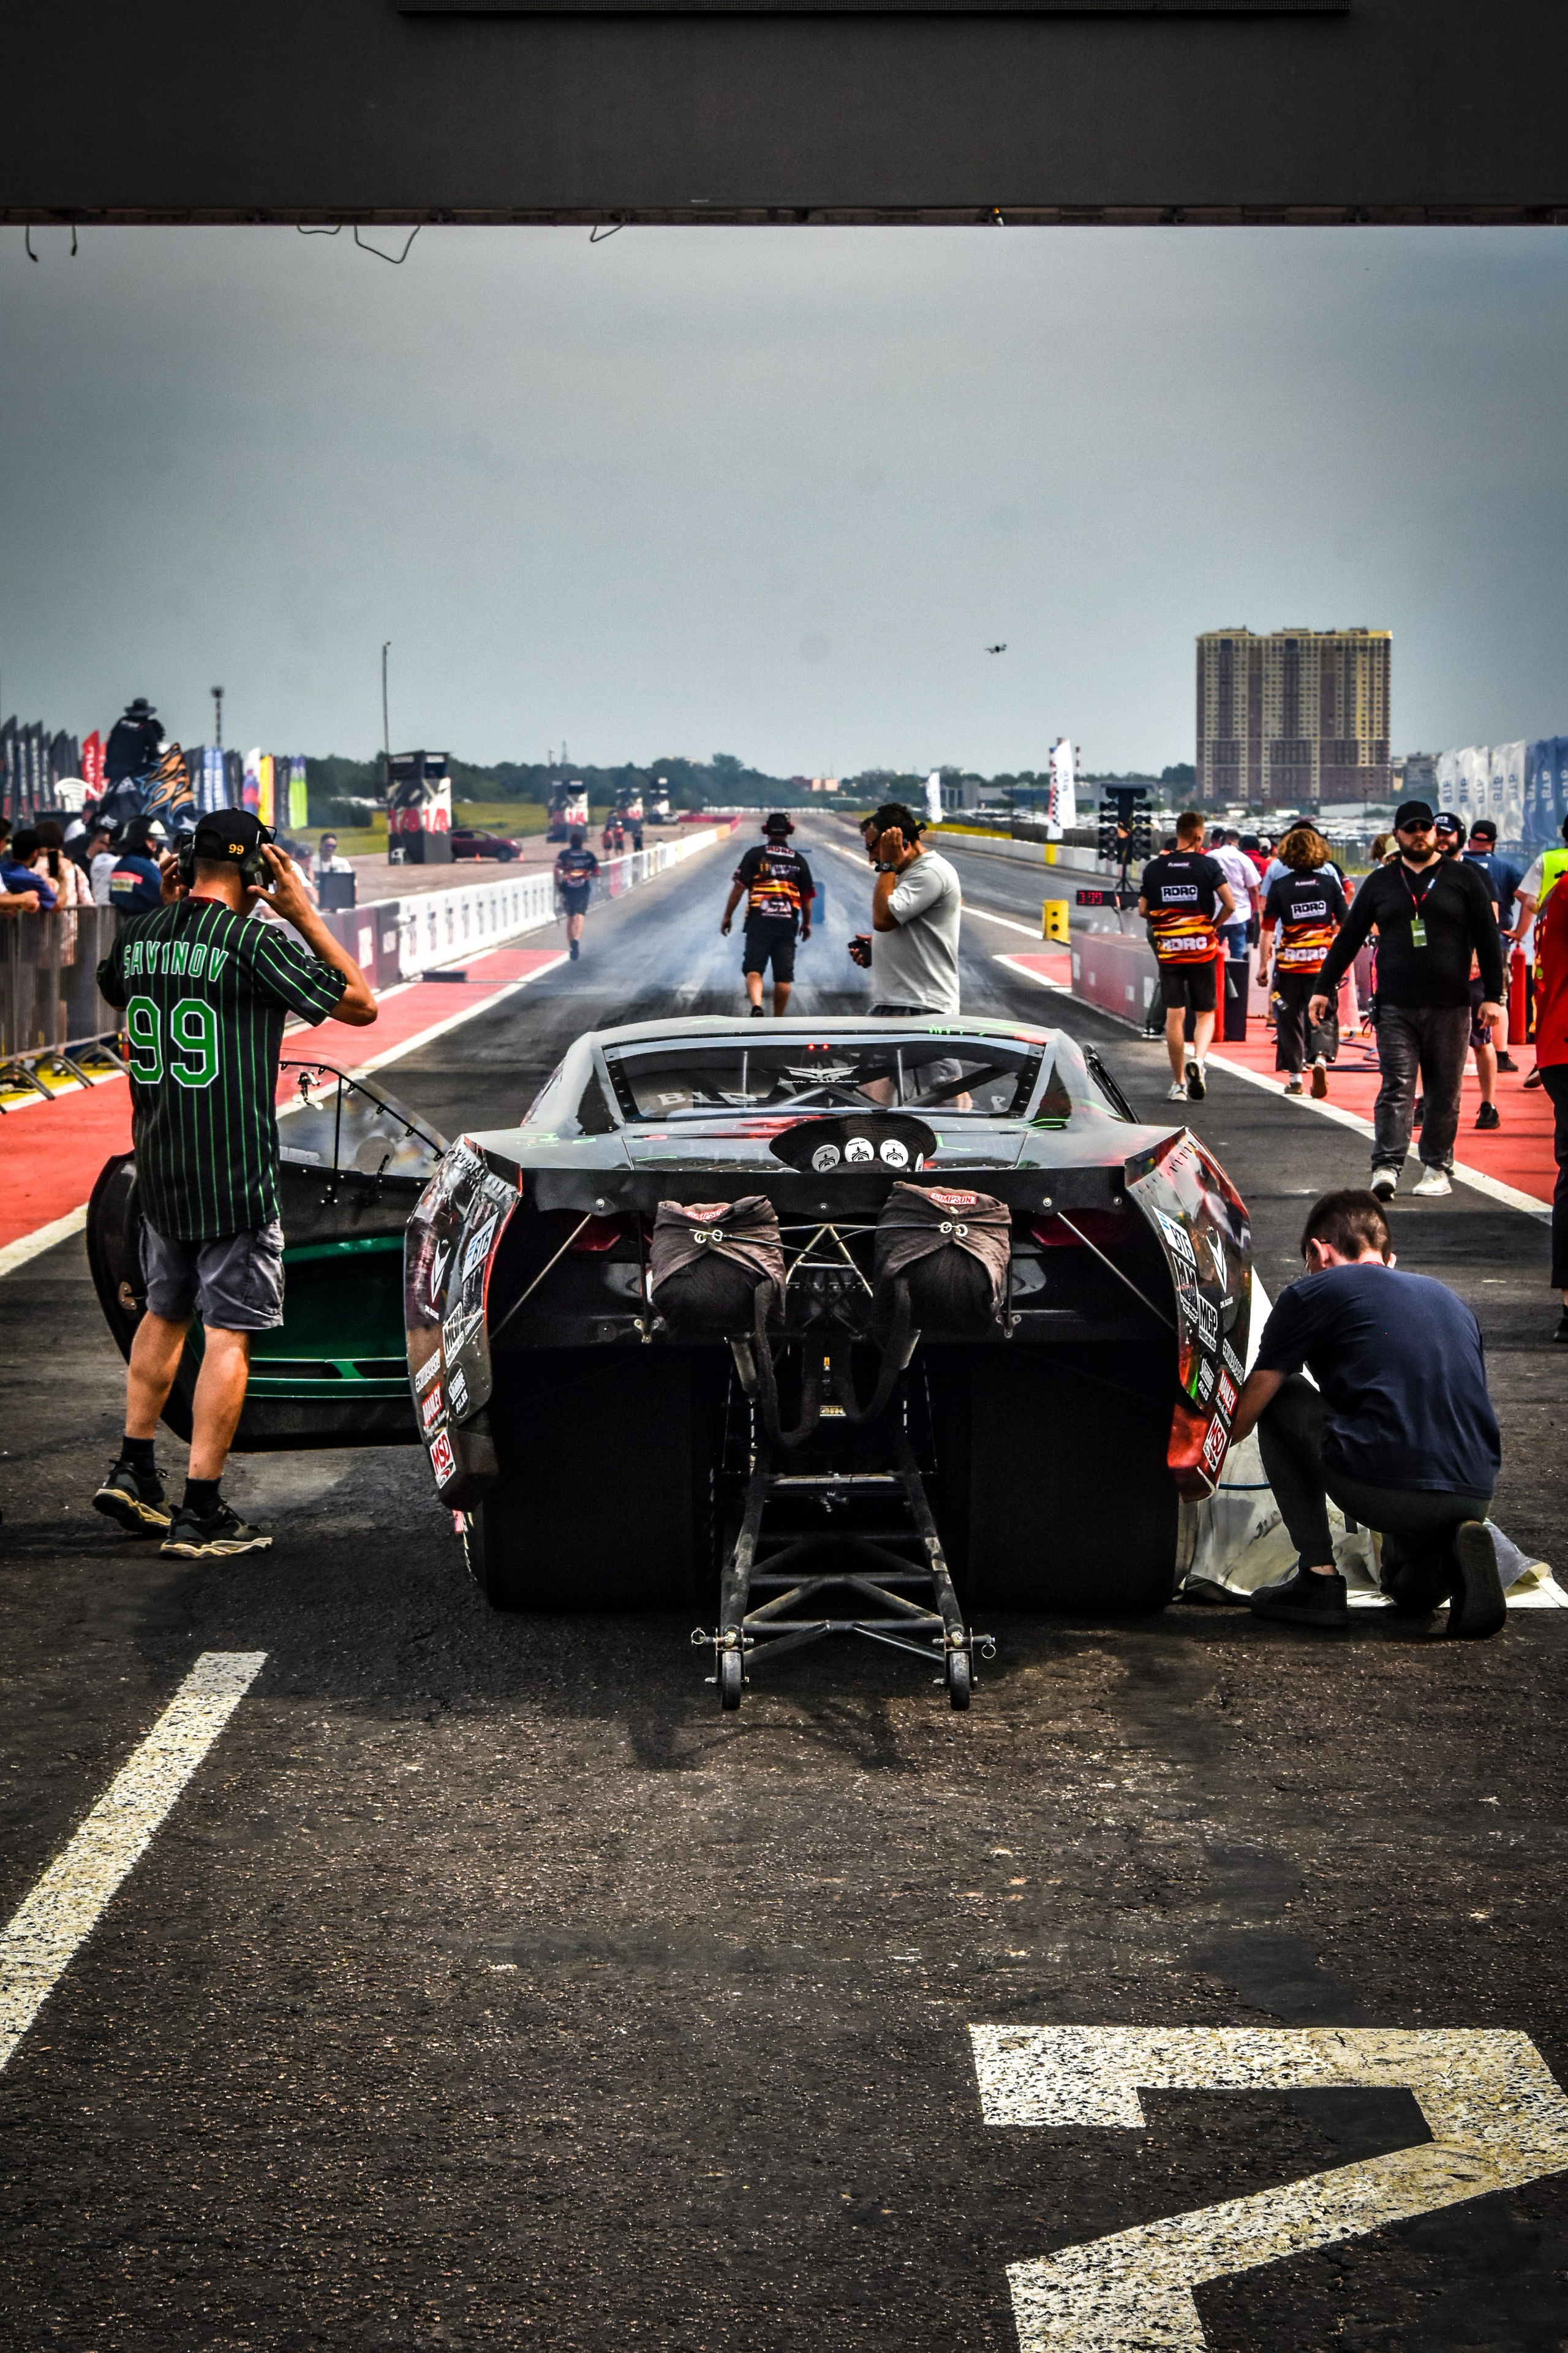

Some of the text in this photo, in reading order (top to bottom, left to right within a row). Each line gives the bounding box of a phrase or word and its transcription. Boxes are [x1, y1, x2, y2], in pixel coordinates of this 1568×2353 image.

[228, 844, 244, 855] 99
[1164, 886, 1197, 896] RDRC
[1293, 902, 1325, 913] RDRC
[124, 940, 229, 982] SAVINOV
[1162, 936, 1207, 951] RDRC
[126, 995, 219, 1088] 99
[933, 1194, 972, 1204] SIMPSON
[471, 1225, 492, 1267] ВТБ
[1169, 1223, 1193, 1262] ВТБ
[1200, 1297, 1217, 1338] MGP
[1219, 1372, 1236, 1412] MANLEY
[431, 1434, 450, 1475] MSD
[1208, 1417, 1225, 1457] MSD
